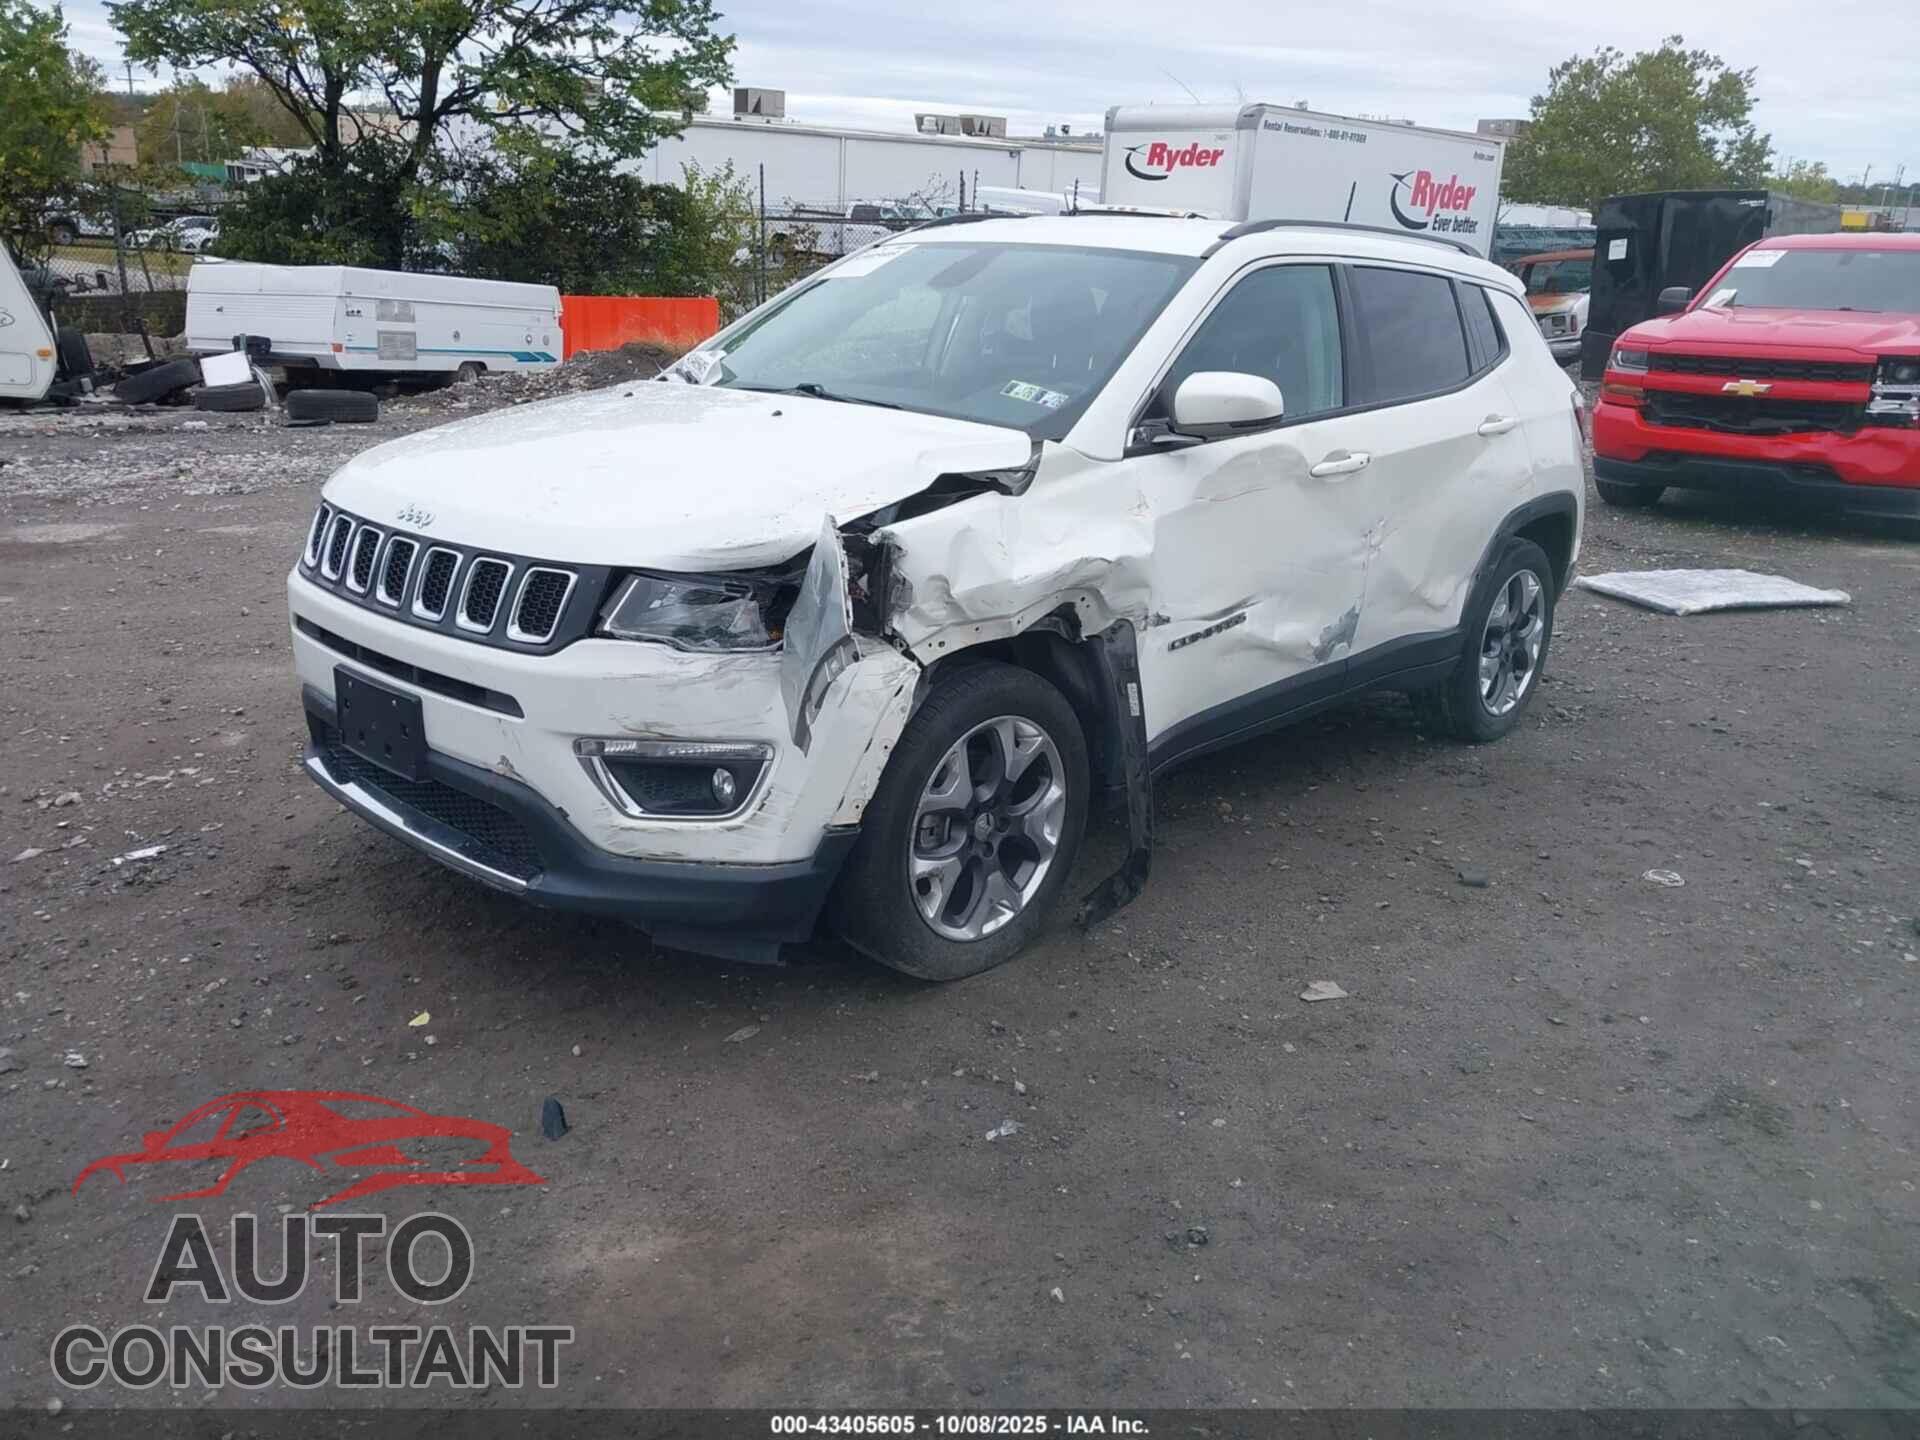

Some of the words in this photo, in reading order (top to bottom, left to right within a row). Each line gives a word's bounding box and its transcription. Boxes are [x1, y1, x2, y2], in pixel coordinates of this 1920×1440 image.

[1146, 142, 1225, 172] Ryder
[1410, 170, 1477, 217] Ryder
[1431, 213, 1453, 232] Ever
[397, 504, 436, 529] Jeep
